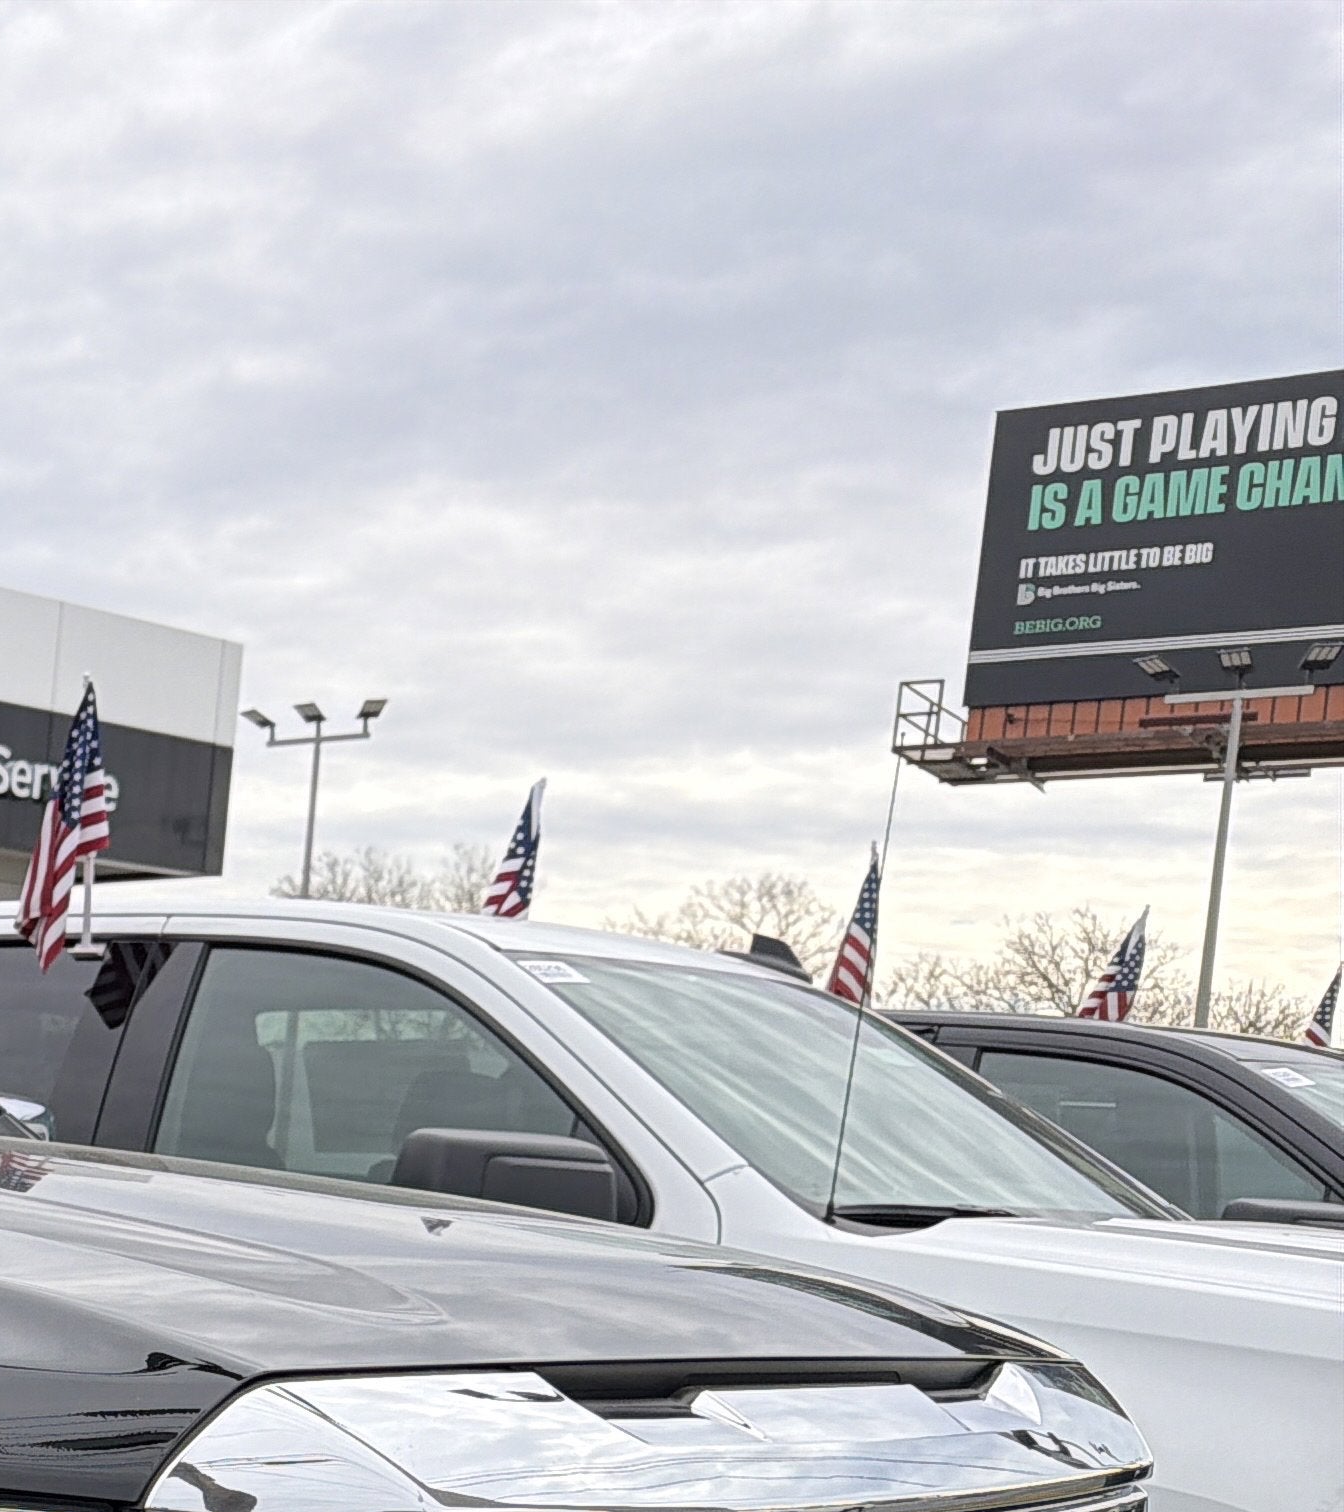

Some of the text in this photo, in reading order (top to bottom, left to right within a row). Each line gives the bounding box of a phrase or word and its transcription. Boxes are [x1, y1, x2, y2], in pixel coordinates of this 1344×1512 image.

[1032, 396, 1338, 475] JUST PLAYING
[1027, 482, 1069, 531] IS
[1073, 479, 1102, 527] A
[1112, 465, 1230, 523] GAME
[1018, 542, 1214, 579] IT TAKES LITTLE TO BE BIG
[1013, 615, 1102, 635] BEBIG.ORG
